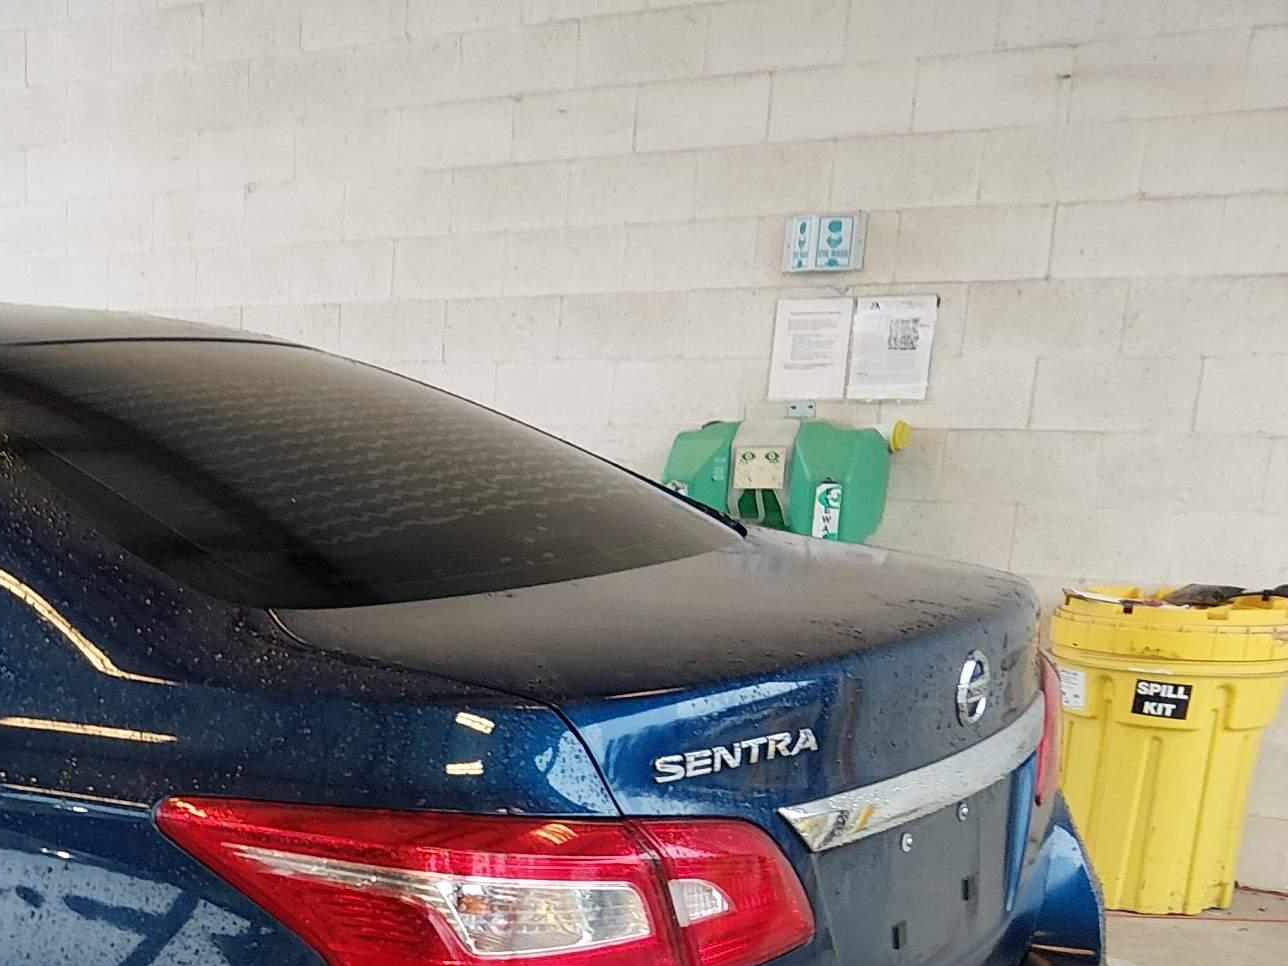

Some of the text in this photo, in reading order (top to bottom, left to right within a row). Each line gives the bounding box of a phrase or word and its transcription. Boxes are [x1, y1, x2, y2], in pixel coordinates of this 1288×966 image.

[1137, 681, 1189, 700] SPILL
[1142, 700, 1177, 717] KIT
[654, 728, 818, 783] SENTRA
